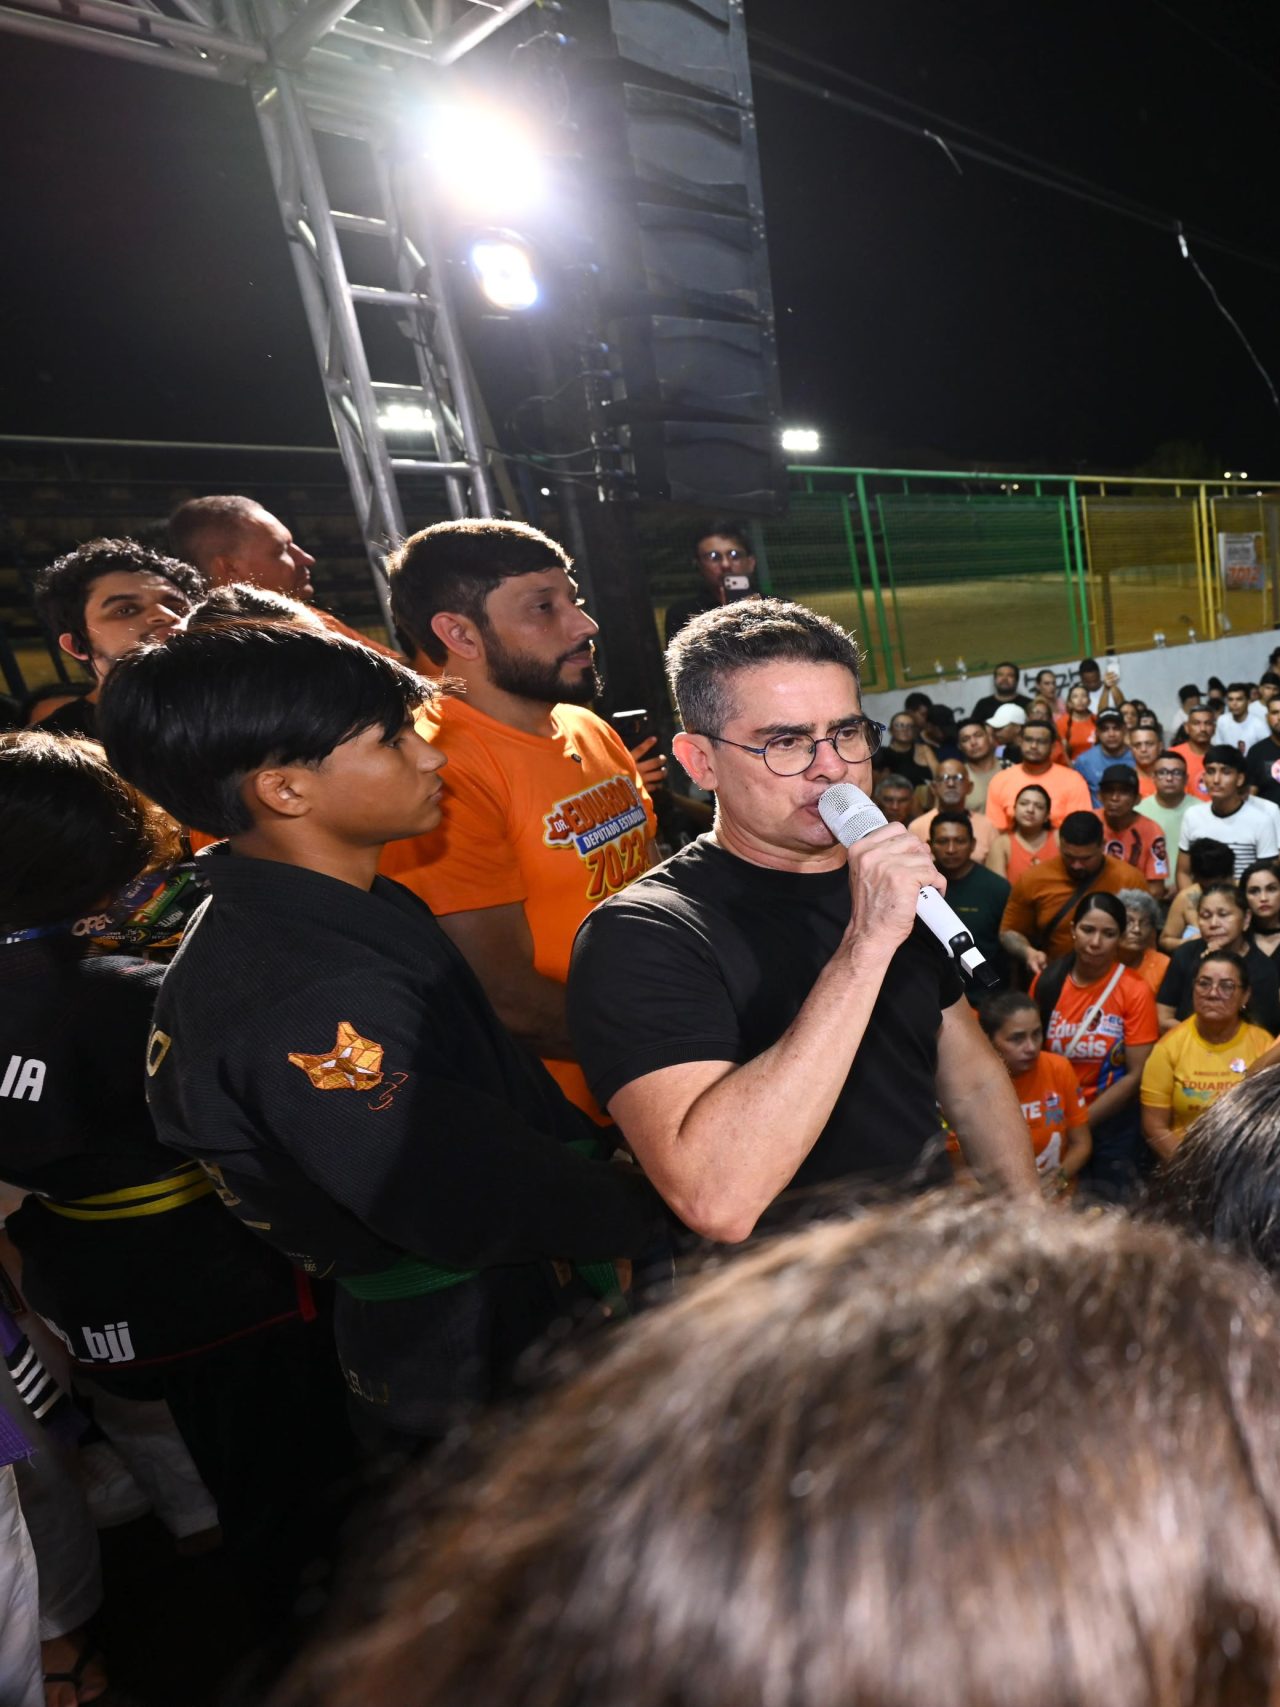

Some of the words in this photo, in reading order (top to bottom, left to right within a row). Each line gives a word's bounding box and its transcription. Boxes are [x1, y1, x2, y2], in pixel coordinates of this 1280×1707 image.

[553, 818, 570, 833] DR.
[560, 777, 639, 836] EDUARDO
[582, 820, 621, 849] DEPUTADO
[618, 809, 646, 831] ESTADUAL
